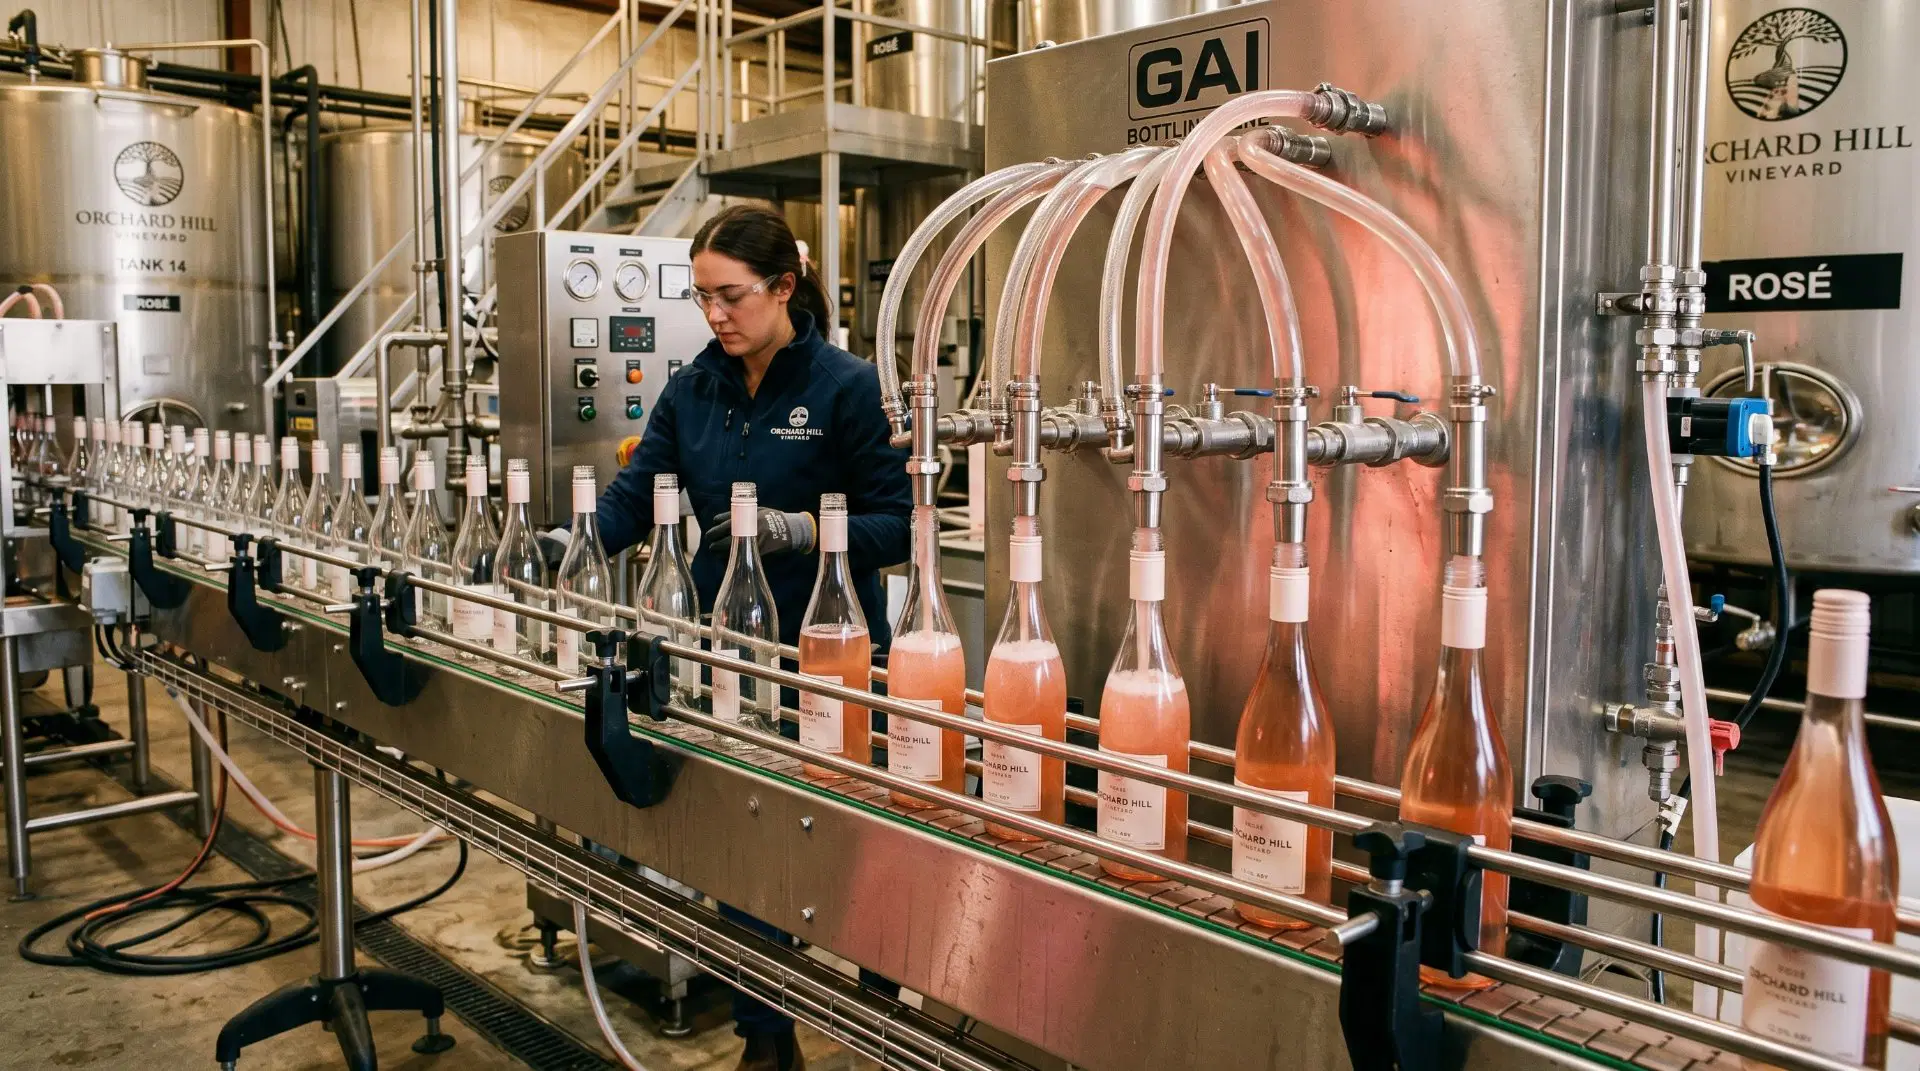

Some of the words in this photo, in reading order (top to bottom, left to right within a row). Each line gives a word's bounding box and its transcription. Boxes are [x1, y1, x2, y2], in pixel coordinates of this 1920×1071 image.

[1137, 30, 1259, 108] GAI
[1128, 116, 1206, 145] BOTTLIN
[1704, 132, 1821, 165] CHARD
[1833, 125, 1913, 152] HILL
[1726, 161, 1842, 184] VINEYARD
[76, 210, 175, 229] ORCHARD
[181, 215, 218, 232] HILL
[118, 258, 164, 272] TANK
[169, 260, 187, 273] 14
[1728, 263, 1833, 301] ROSÉ
[806, 428, 824, 436] HILL
[912, 737, 931, 745] HILL
[1010, 765, 1029, 773] HILL
[1131, 799, 1152, 808] HILL
[1269, 839, 1292, 849] HILL
[1814, 988, 1846, 1004] HILL
